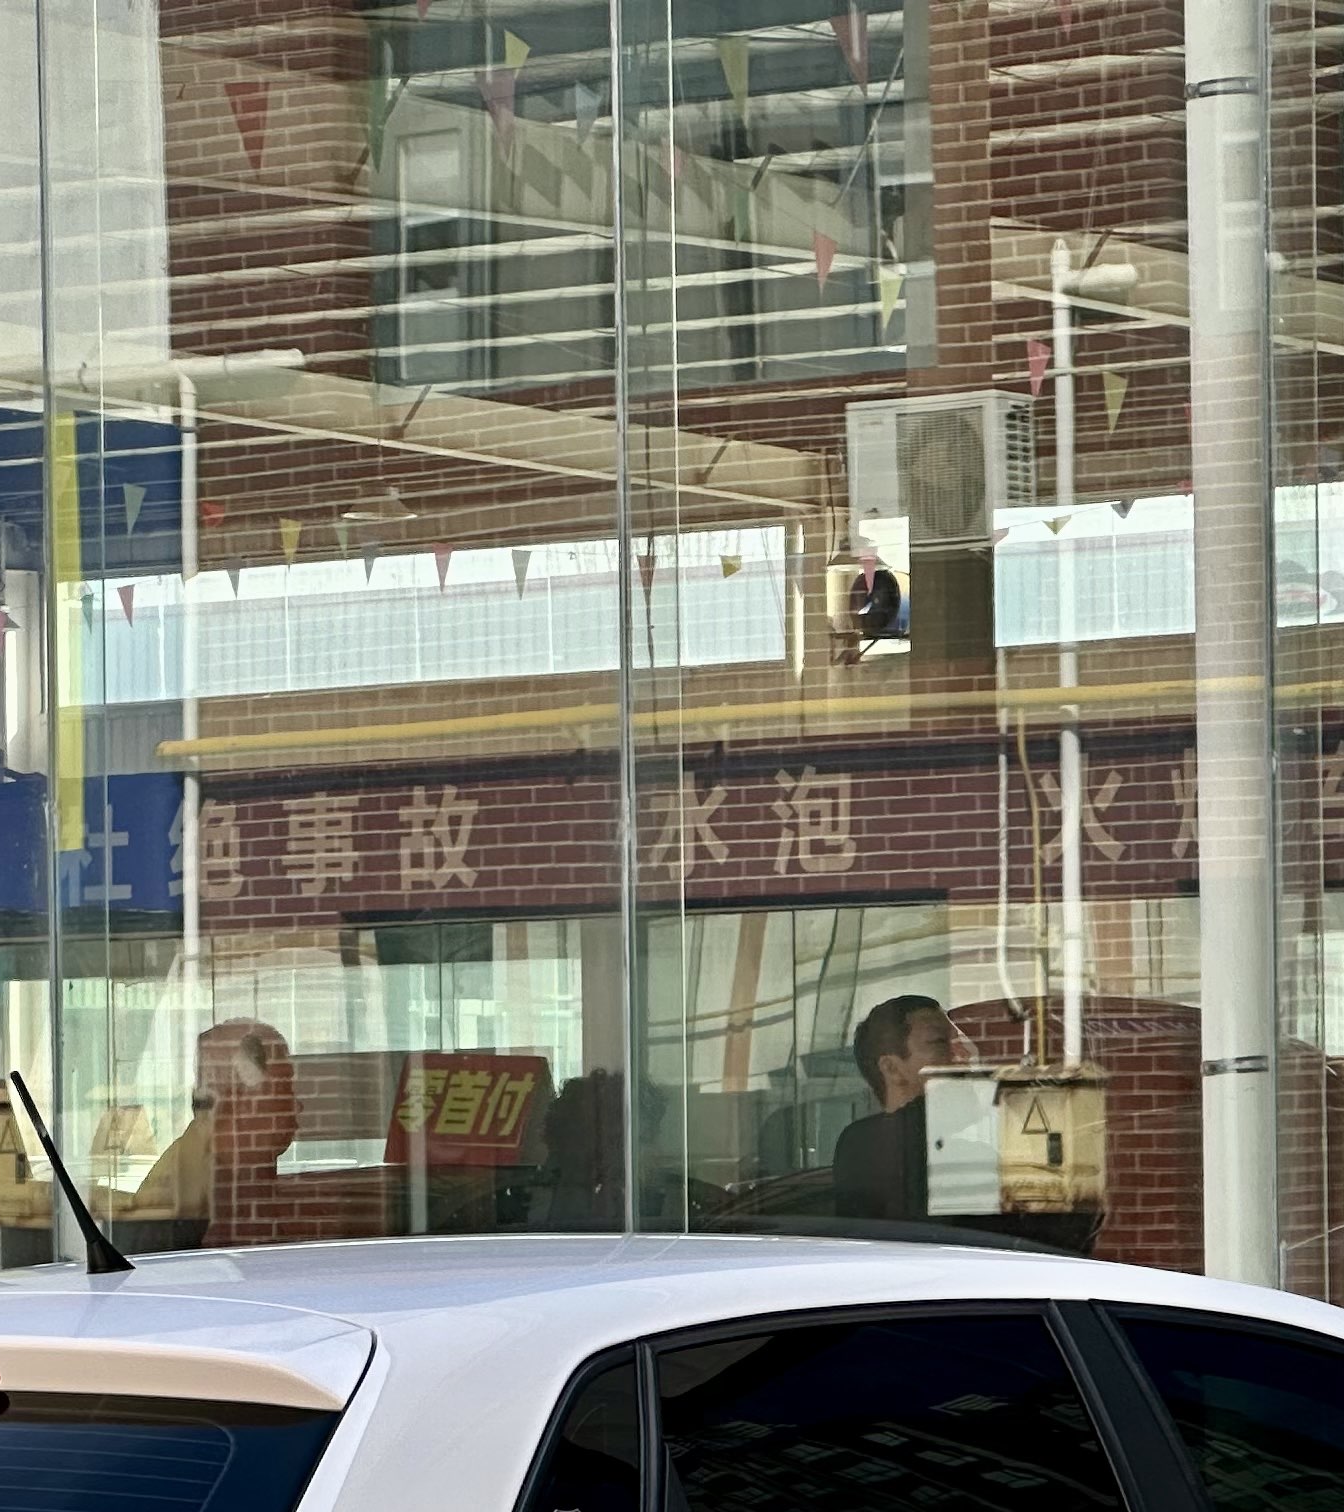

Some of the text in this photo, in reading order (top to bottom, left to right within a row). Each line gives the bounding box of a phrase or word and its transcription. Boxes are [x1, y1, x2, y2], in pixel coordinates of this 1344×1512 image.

[649, 765, 858, 882] 水泡
[396, 1068, 536, 1136] 零首付
